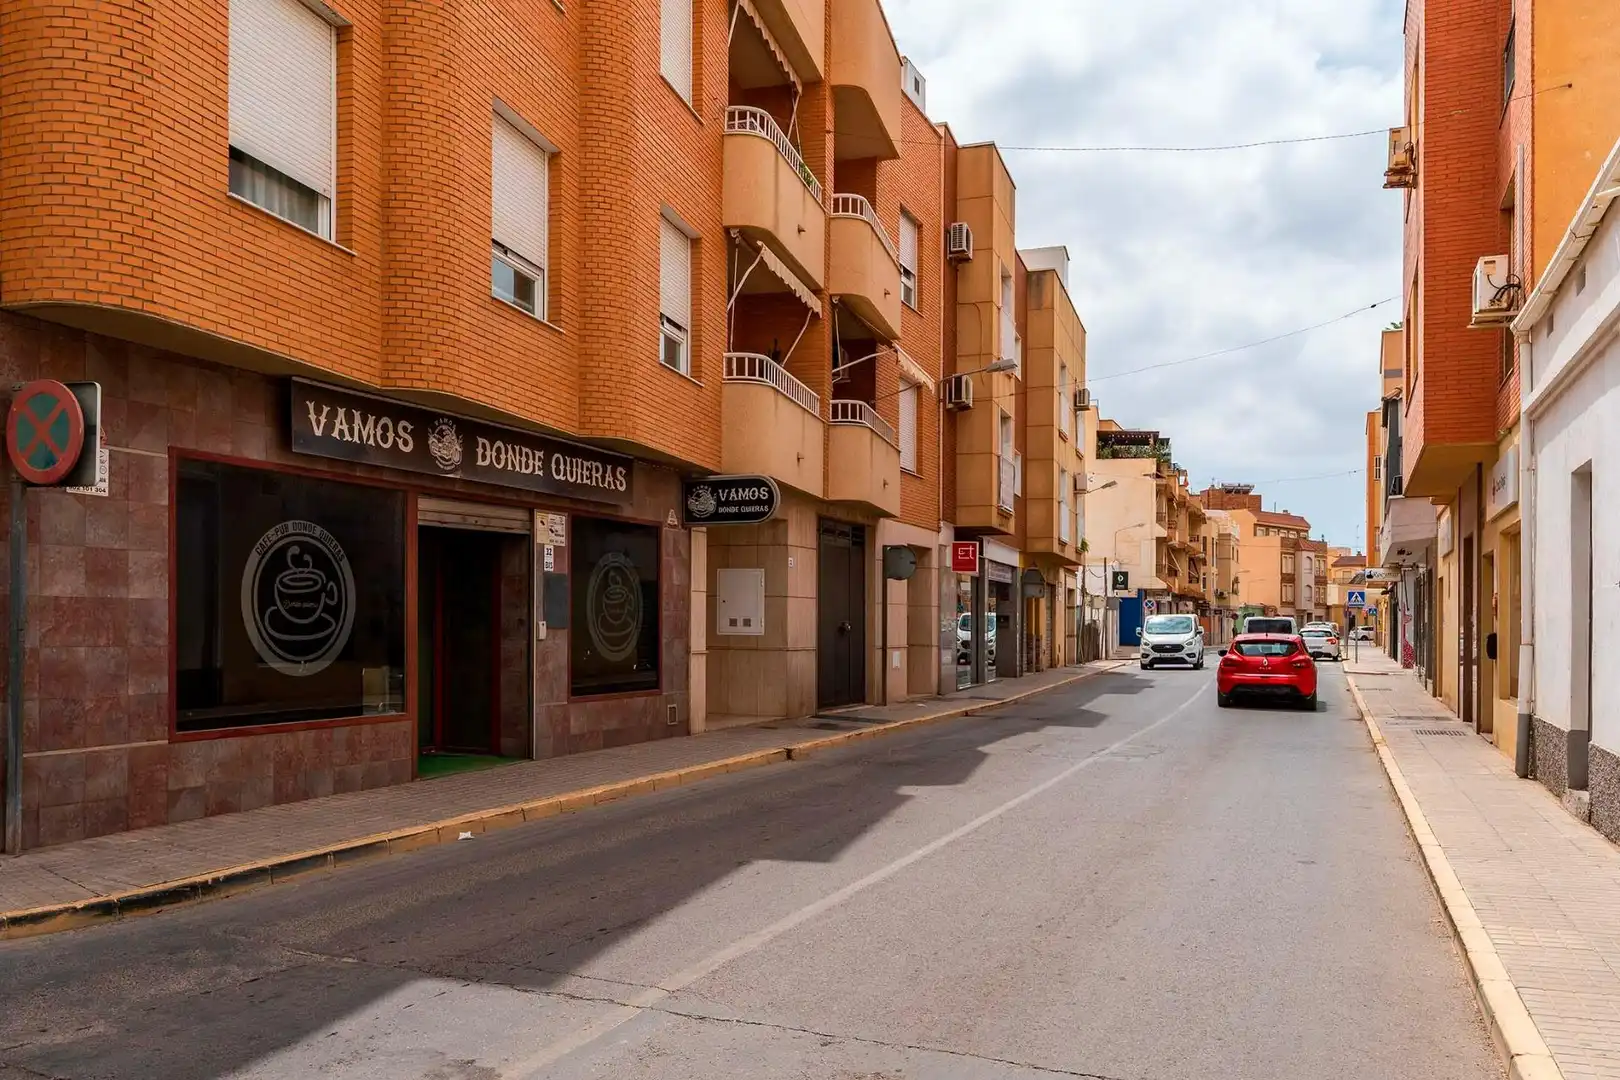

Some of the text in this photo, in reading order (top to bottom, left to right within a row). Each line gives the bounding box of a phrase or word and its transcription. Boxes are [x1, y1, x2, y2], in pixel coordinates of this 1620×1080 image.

[306, 399, 627, 492] VAMOS DONDE QUIERAS
[718, 486, 769, 501] VAMOS
[718, 505, 769, 514] DONDE QUIERAS
[292, 521, 318, 534] DONDE
[319, 529, 345, 562] QUIERAS
